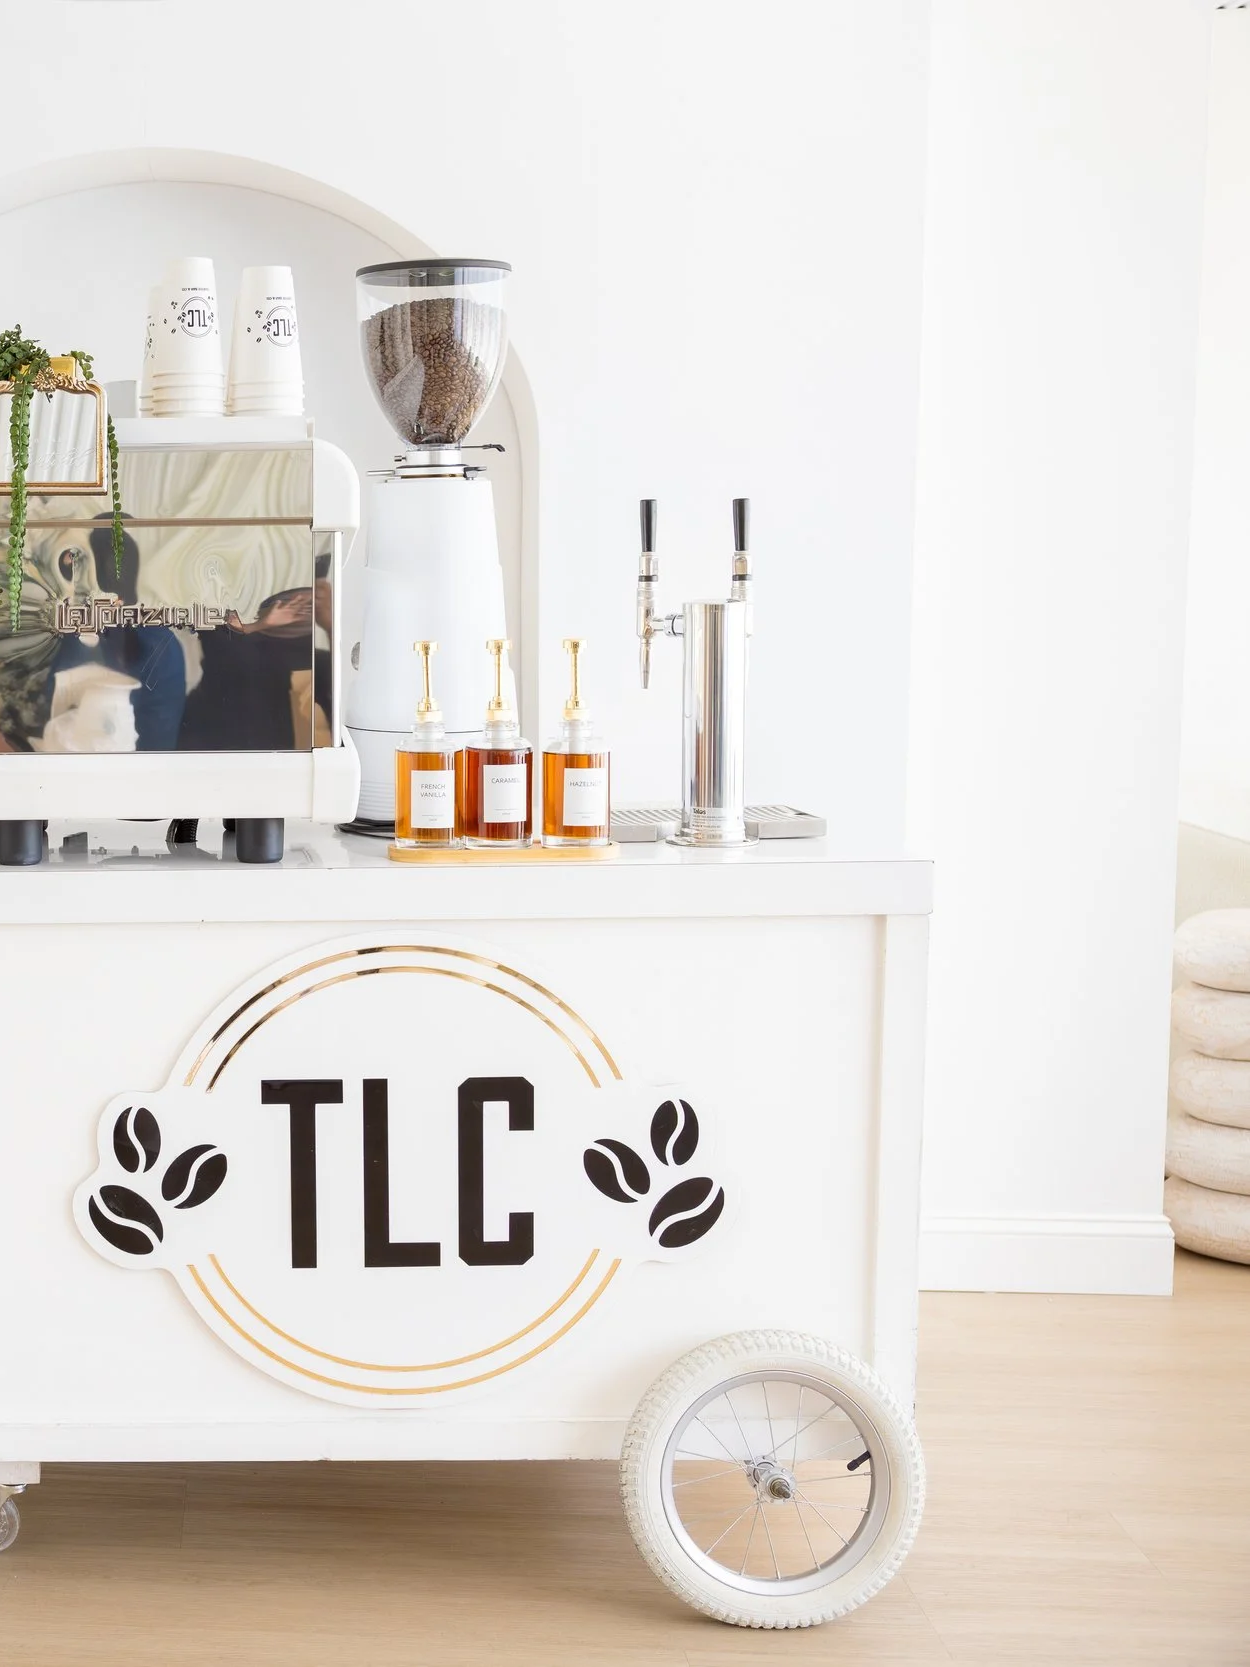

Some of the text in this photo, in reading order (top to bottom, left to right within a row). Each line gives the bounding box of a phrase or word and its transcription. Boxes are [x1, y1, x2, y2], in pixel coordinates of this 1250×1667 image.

[188, 310, 207, 327] TLC
[273, 319, 292, 336] TLC
[260, 1076, 535, 1270] TLC
